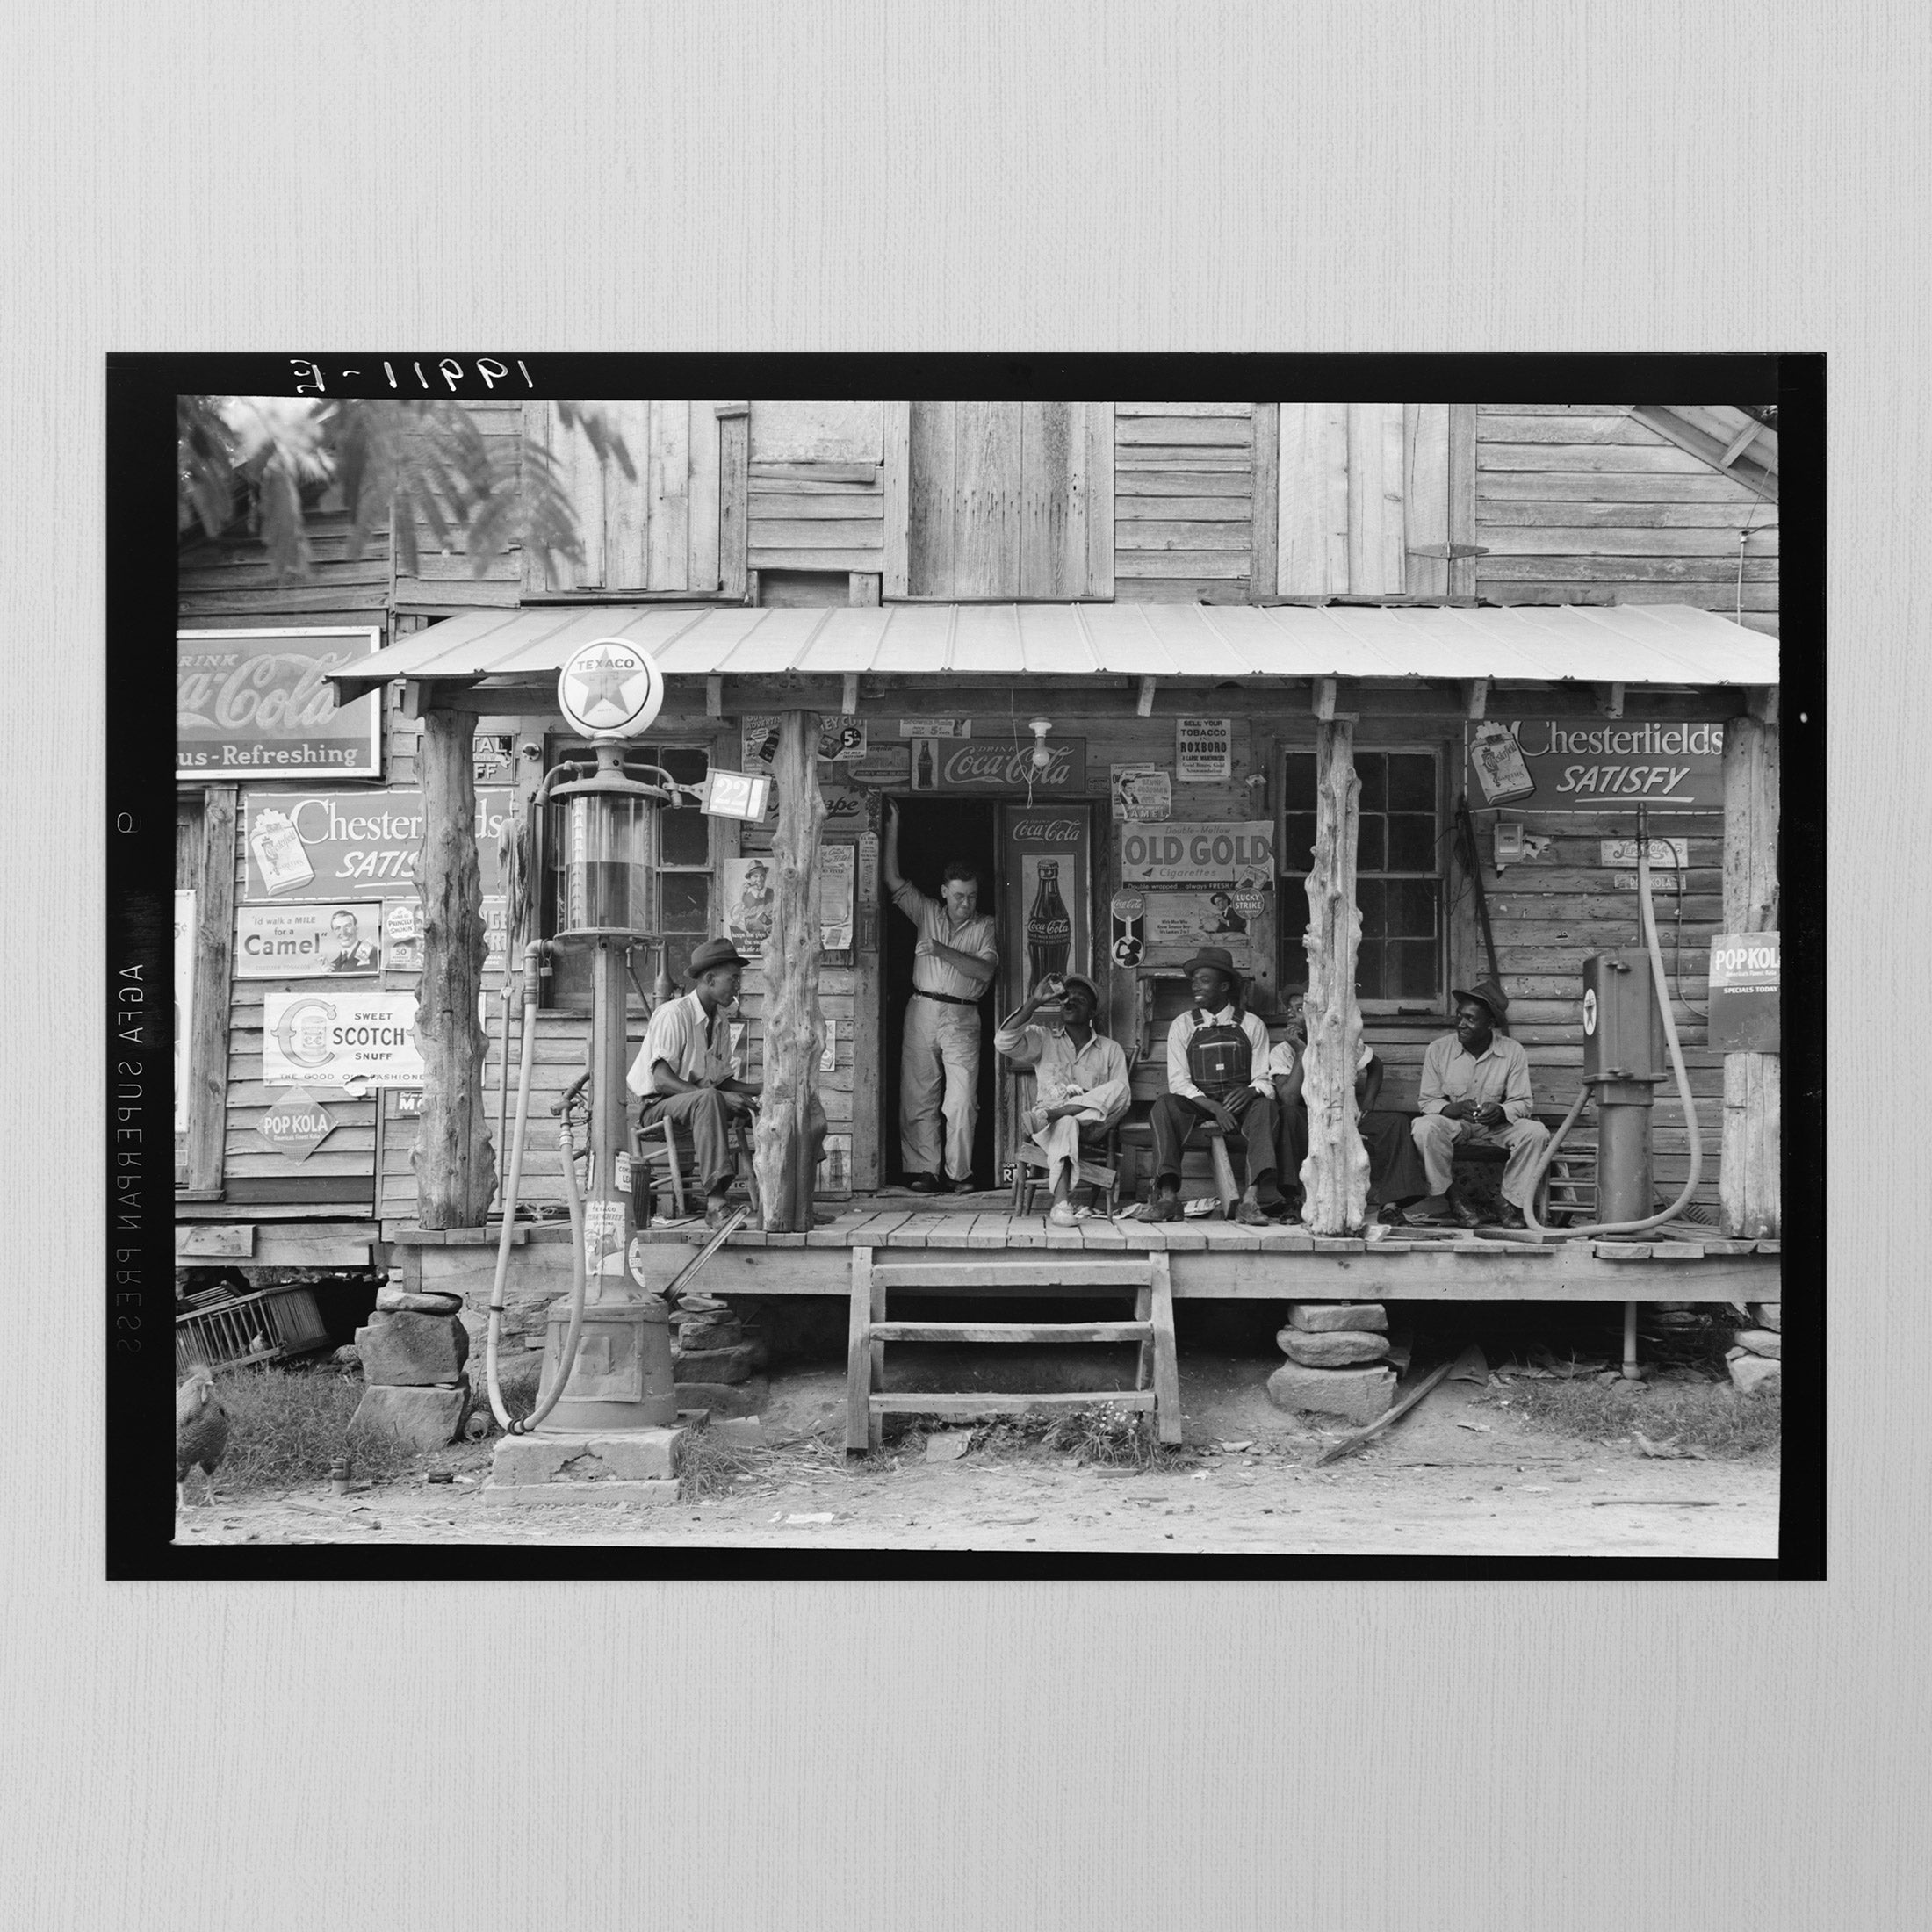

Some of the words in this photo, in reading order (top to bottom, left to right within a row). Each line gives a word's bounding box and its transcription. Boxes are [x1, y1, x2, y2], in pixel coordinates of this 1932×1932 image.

[577, 659, 635, 671] TEXACO
[1510, 721, 1723, 757] Chesterfields
[1180, 741, 1227, 753] ROXBORO
[943, 746, 1075, 785] Coca-Cola
[1556, 765, 1690, 795] SATISFY
[714, 778, 749, 807] 22
[1130, 808, 1166, 818] AMEL
[289, 798, 504, 845] Chesterds
[1013, 819, 1082, 841] Coca-Cola
[1124, 835, 1184, 866] OLD
[1189, 835, 1272, 866] GOLD
[335, 850, 415, 879] SATIS
[1159, 868, 1217, 879] Cigarettes
[1185, 883, 1208, 891] always
[1114, 898, 1143, 910] Coca-Cola
[1235, 901, 1262, 910] STRIKE
[266, 916, 285, 926] walk
[294, 916, 316, 925] MILE
[274, 927, 286, 936] for
[395, 948, 407, 956] 50
[1715, 948, 1748, 970] POP
[1747, 947, 1781, 970] KOL
[332, 1027, 405, 1046] SCOTCH
[355, 1052, 393, 1061] SNUFF
[264, 1115, 291, 1135] POP
[291, 1114, 328, 1134] KOLA
